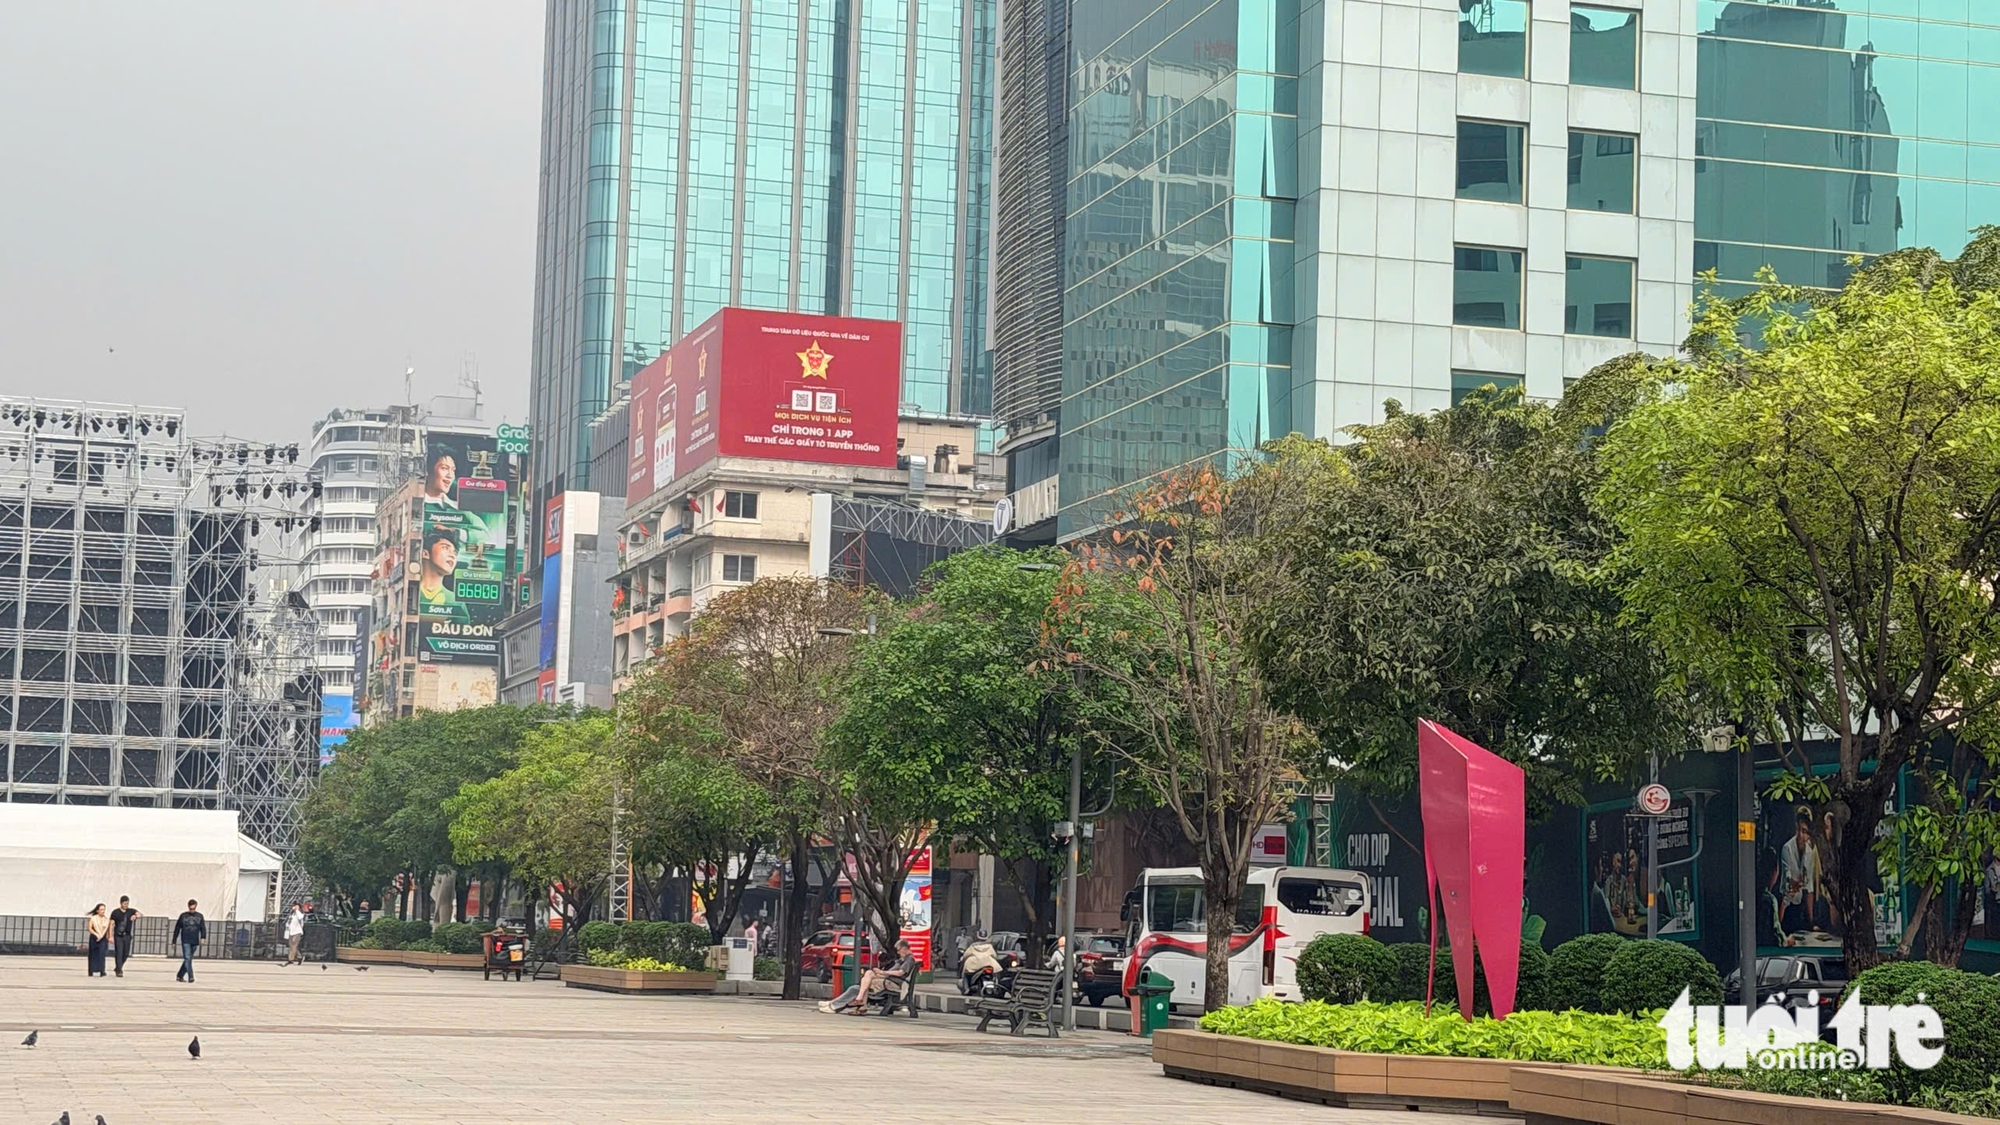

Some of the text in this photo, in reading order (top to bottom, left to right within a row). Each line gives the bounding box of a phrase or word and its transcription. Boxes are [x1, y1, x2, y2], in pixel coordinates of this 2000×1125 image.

[774, 412, 852, 424] MỌI DỊCH VỤ TIỆN ÍCH
[772, 423, 854, 438] CHỈ TRONG 1 APP
[744, 435, 880, 452] THAY THẾ CÁC GIẤY TỜ TRUYỀN THỐNG
[432, 620, 493, 637] ĐẤU ĐƠN
[437, 641, 449, 649] VÔ
[470, 644, 496, 652] ORDER
[1347, 833, 1389, 872] CHO DỊP
[1369, 876, 1404, 927] CIAL
